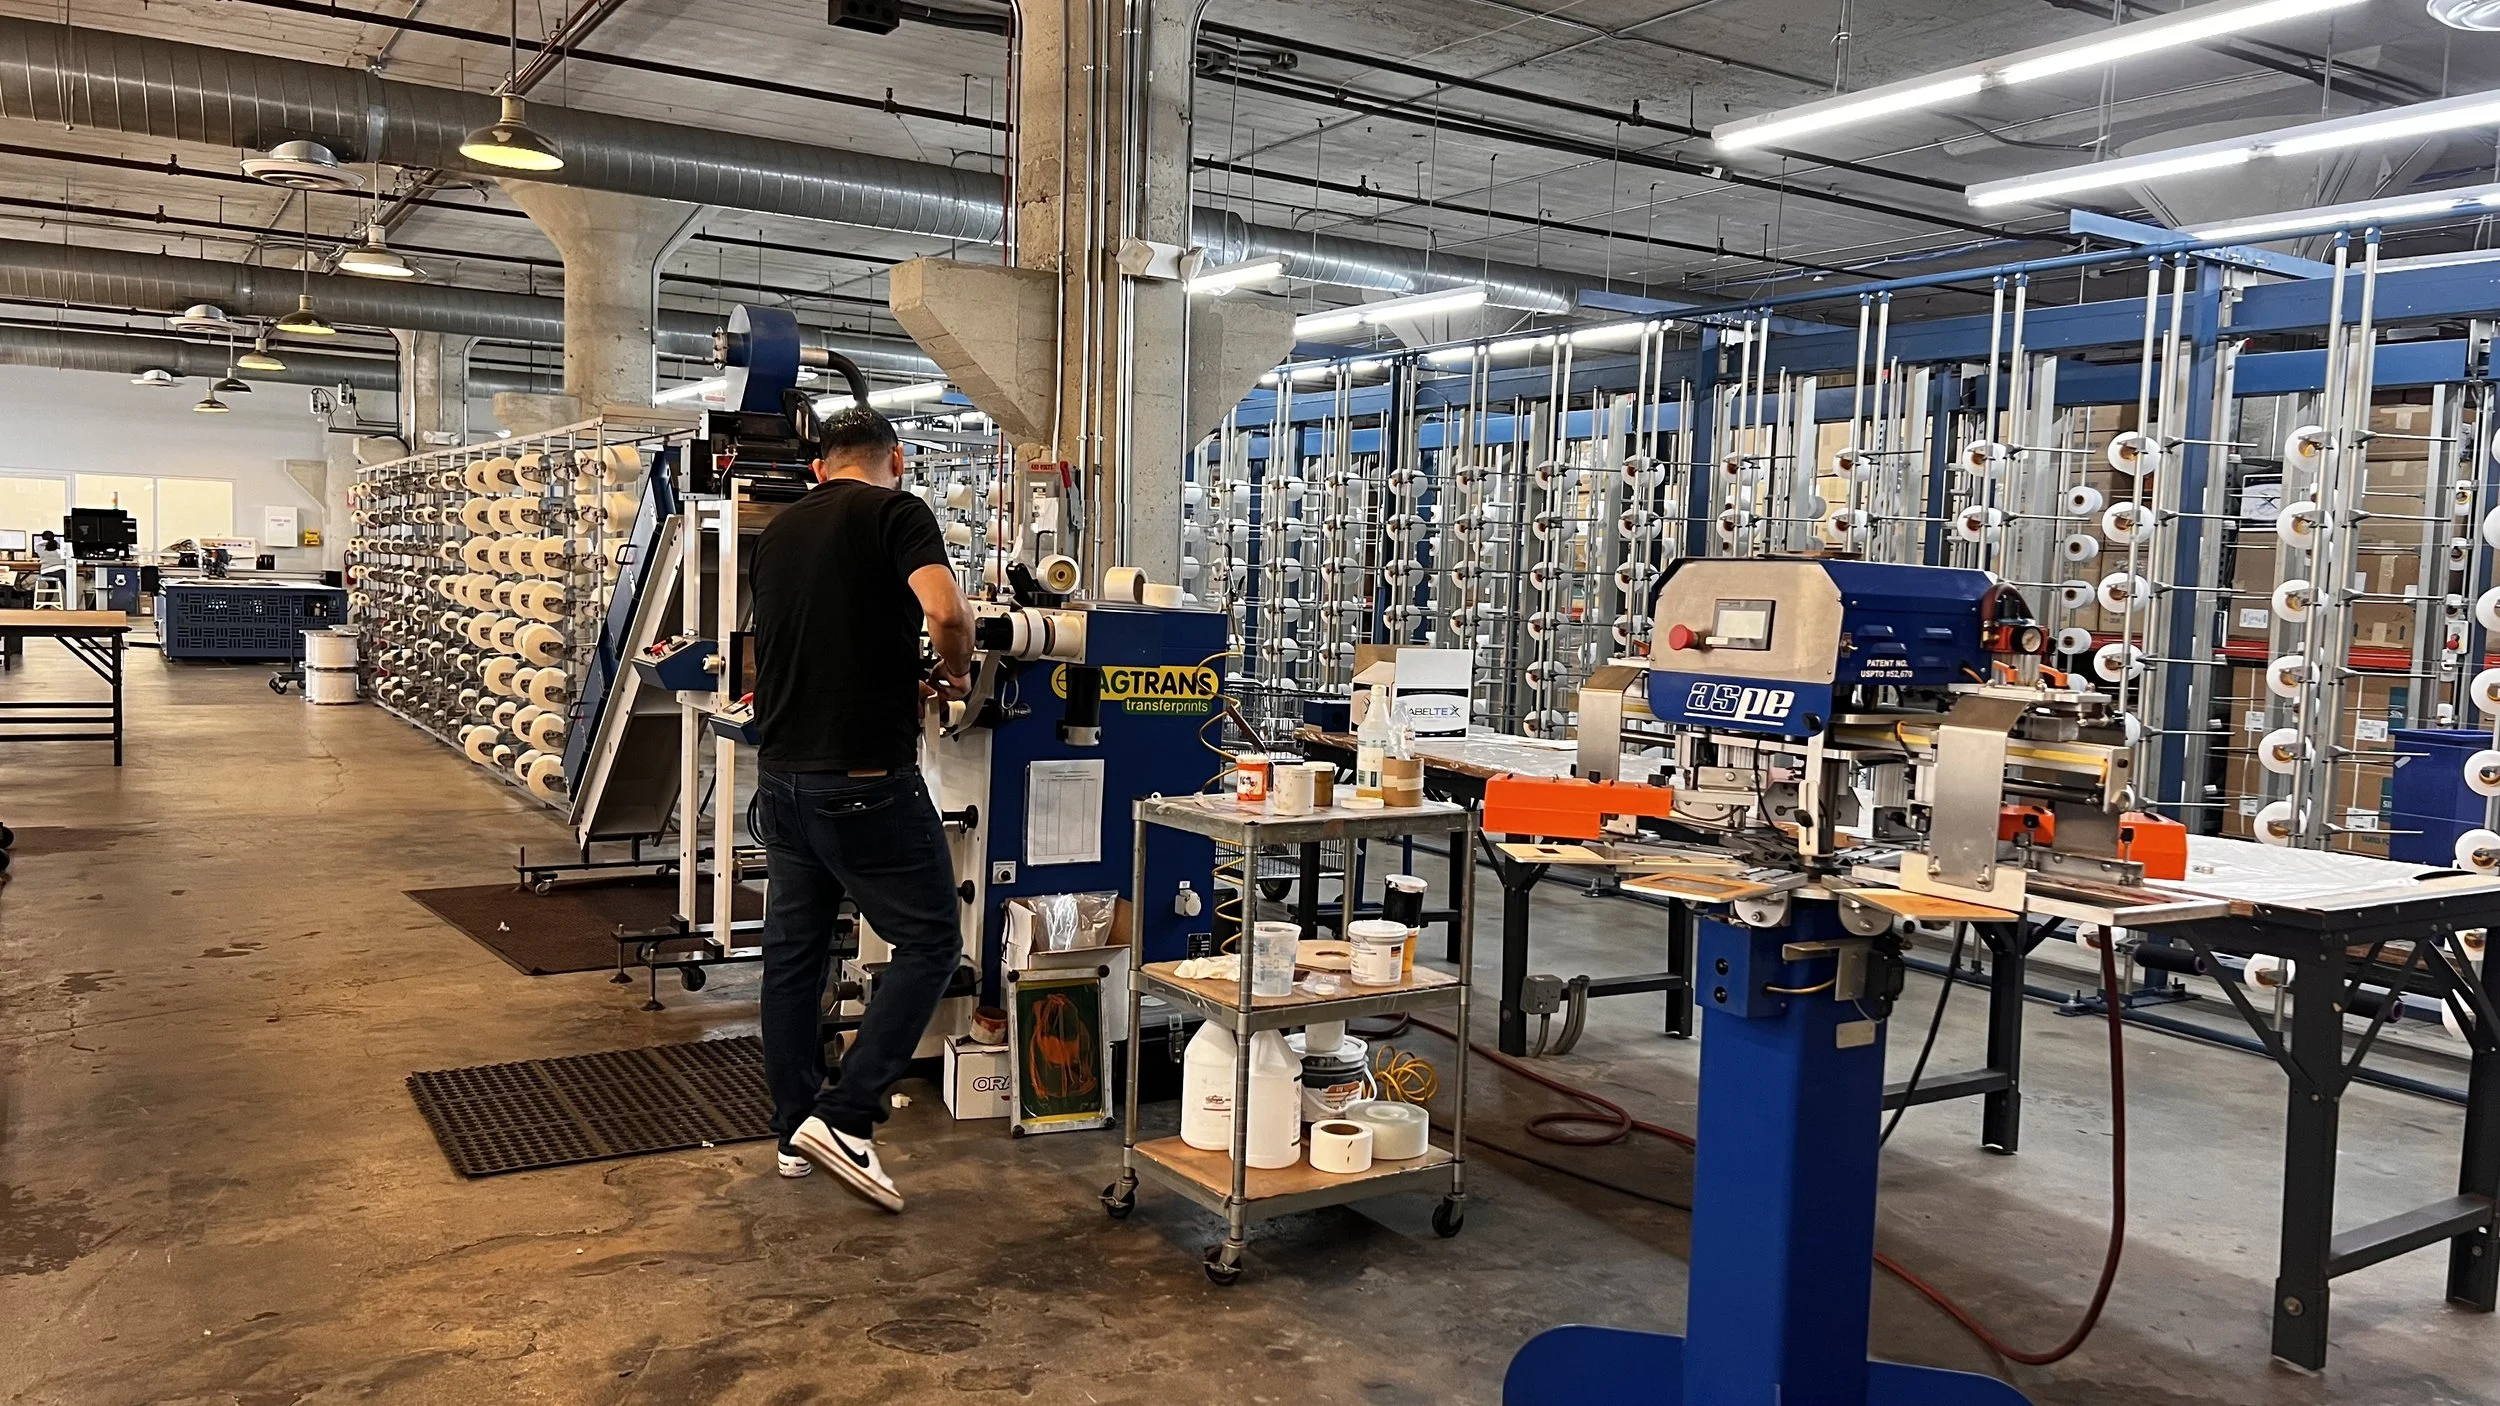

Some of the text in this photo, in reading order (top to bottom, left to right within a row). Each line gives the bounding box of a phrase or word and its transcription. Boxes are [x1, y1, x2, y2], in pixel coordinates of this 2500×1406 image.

[1867, 659, 1894, 667] PATENT
[1861, 670, 1885, 678] USPTO
[1100, 670, 1212, 696] AGTRANS
[1126, 699, 1208, 714] transferprints
[1686, 681, 1795, 721] aspe
[1408, 704, 1461, 717] ABELTEX
[973, 1076, 1010, 1092] ORA
